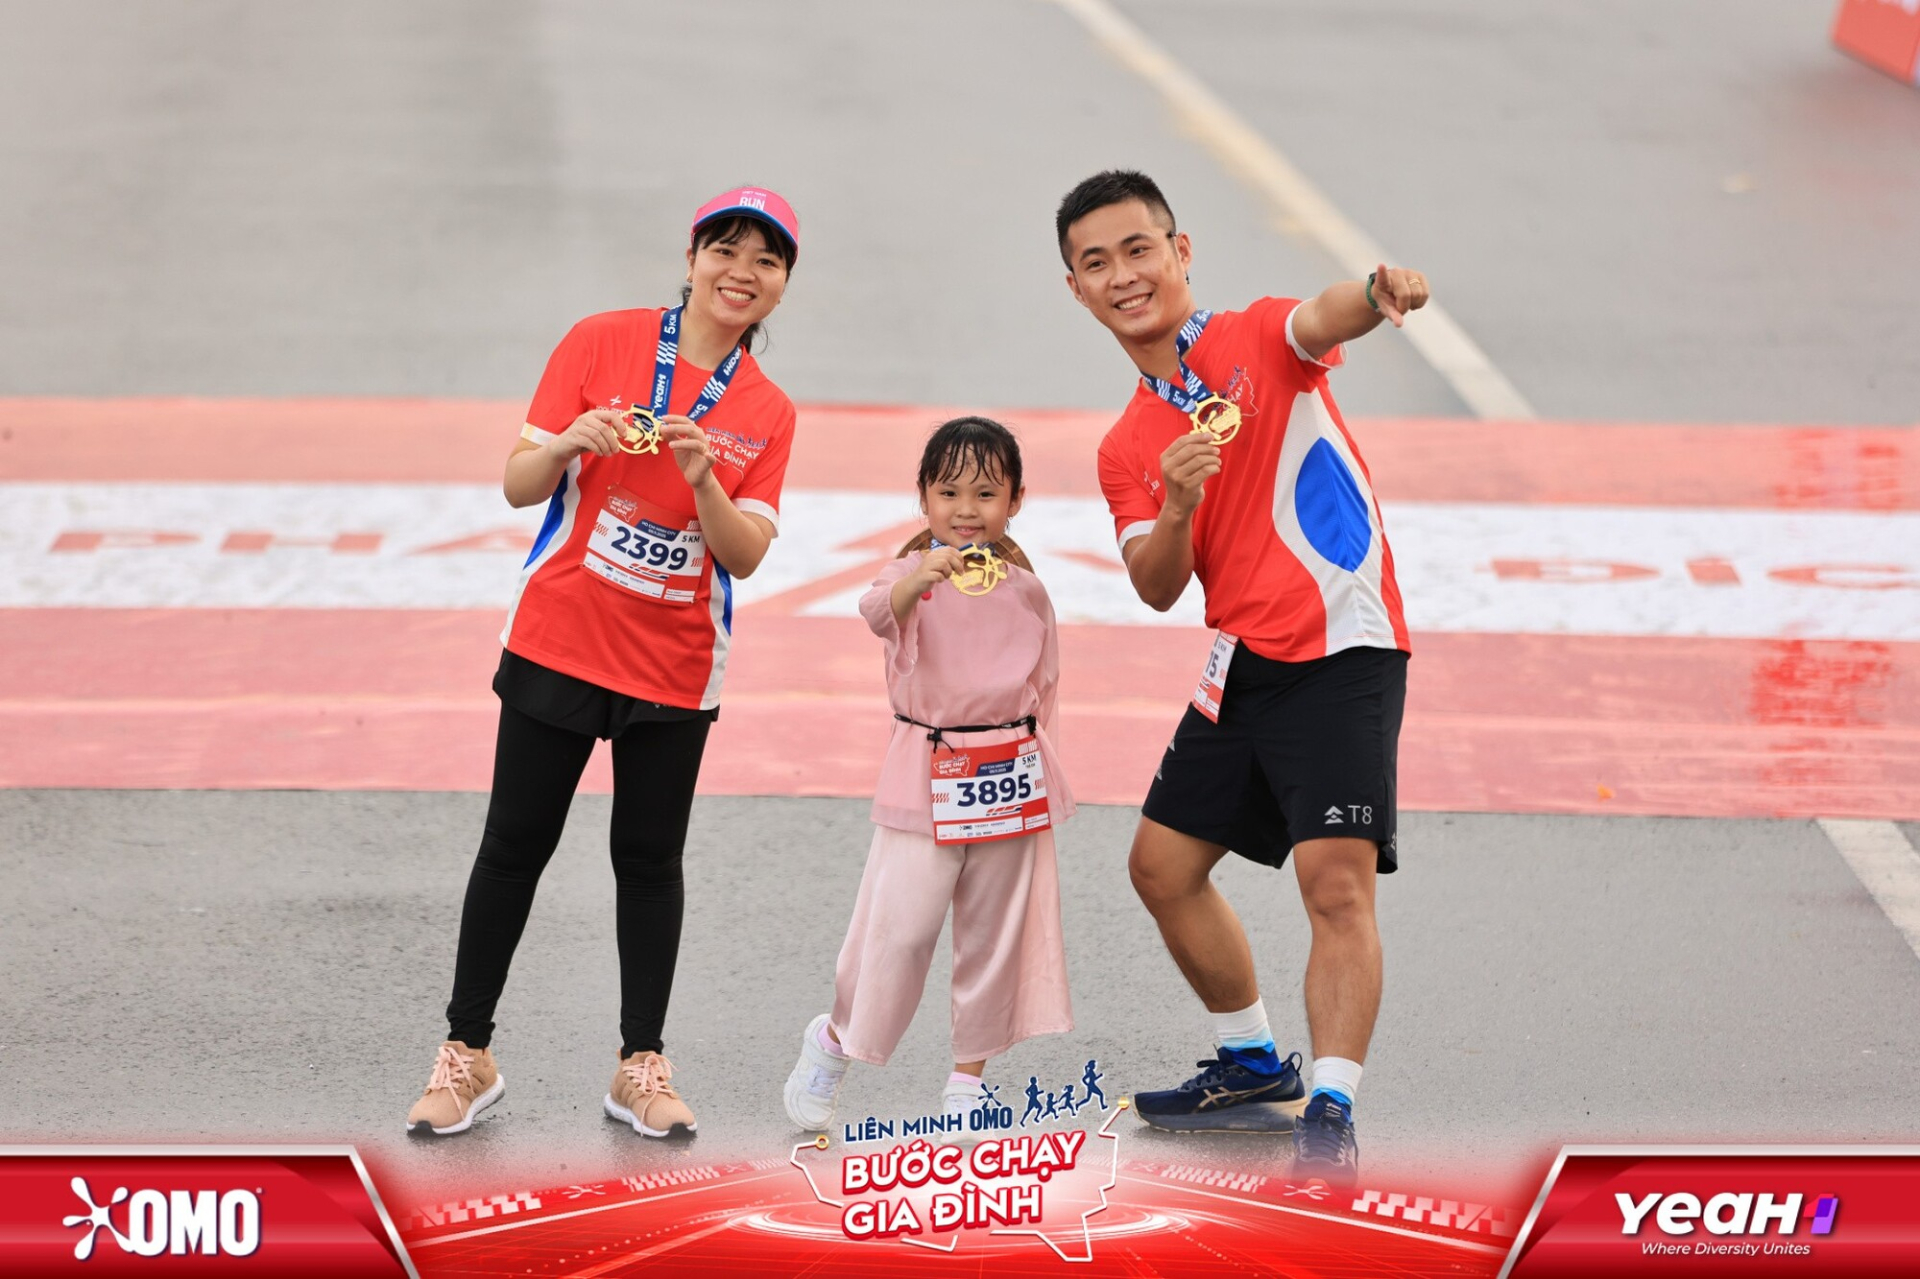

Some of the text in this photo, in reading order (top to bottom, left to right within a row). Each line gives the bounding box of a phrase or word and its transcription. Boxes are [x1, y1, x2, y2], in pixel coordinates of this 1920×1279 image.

[739, 196, 766, 211] RUN
[664, 314, 677, 335] 5KM
[610, 526, 688, 571] 2399
[1022, 754, 1037, 765] 5 KM
[957, 773, 1031, 807] 3895
[1347, 804, 1373, 825] T8
